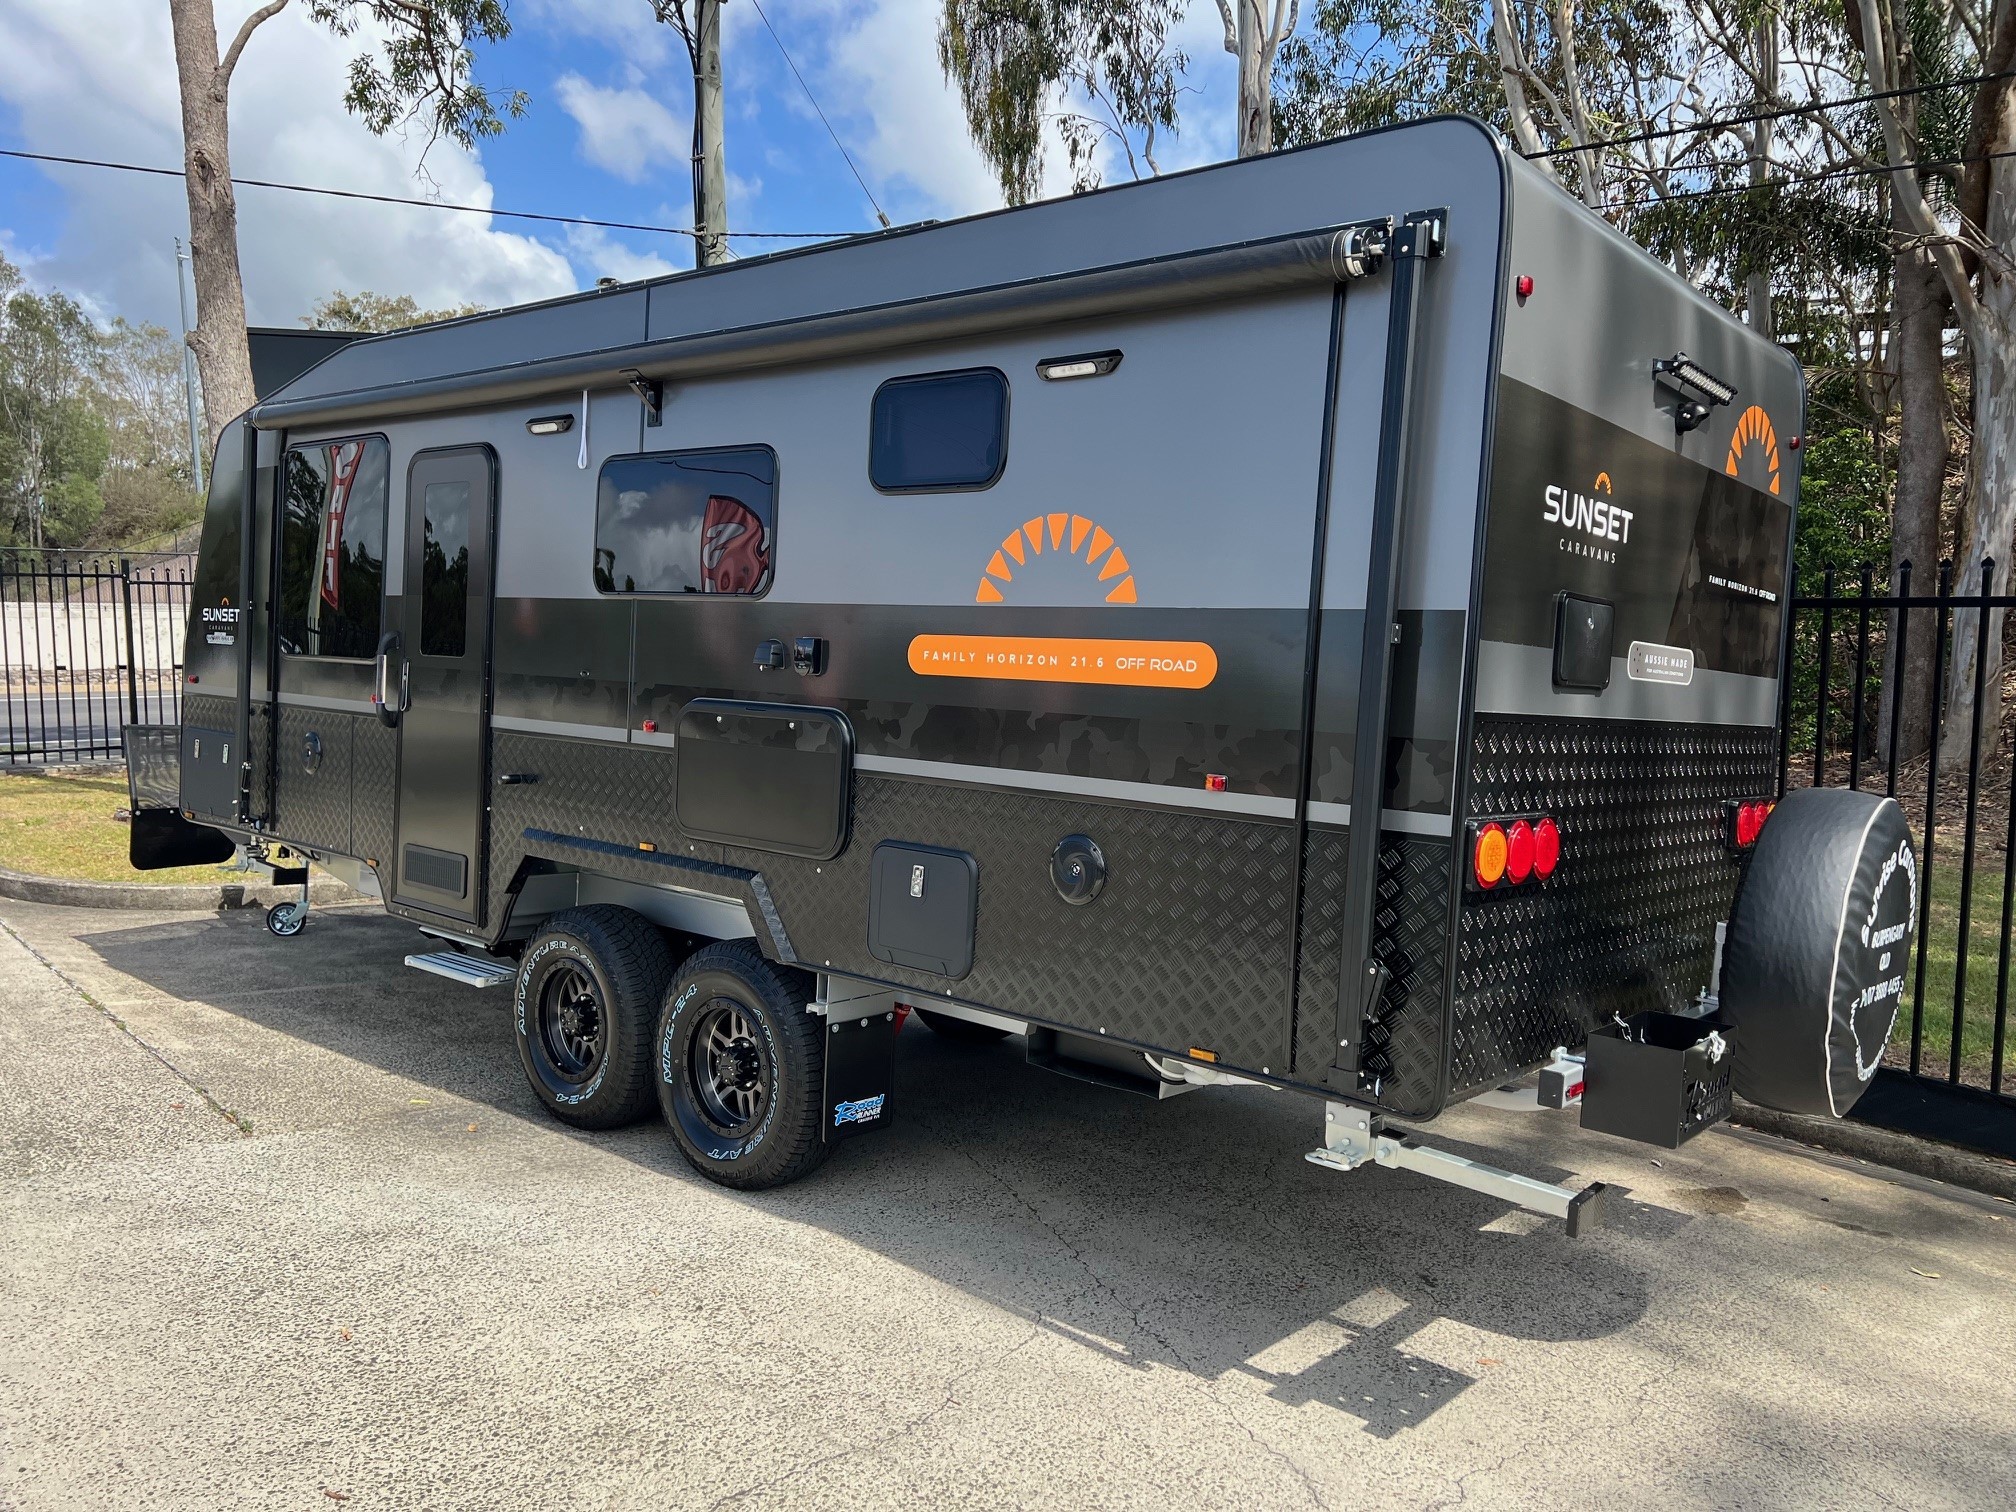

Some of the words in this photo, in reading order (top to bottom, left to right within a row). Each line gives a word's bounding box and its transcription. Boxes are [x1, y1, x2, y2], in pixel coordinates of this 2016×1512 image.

[1543, 484, 1634, 544] SUNSET
[1559, 538, 1617, 564] CARAVANS
[1708, 575, 1727, 587] FAMILY
[1728, 580, 1748, 593] HORIZON
[202, 607, 240, 622] SUNSET
[923, 650, 976, 663] FAMILY
[987, 652, 1059, 667] HORIZON
[1071, 656, 1105, 669] 21.6
[1115, 657, 1146, 671] OFF
[1149, 658, 1198, 673] ROAD
[1644, 654, 1668, 667] AUSSIE
[1670, 658, 1688, 669] MADE
[1861, 850, 1897, 948] Sunrise
[1897, 839, 1916, 933] Caravans
[517, 939, 569, 1037] ADVENTURE
[569, 945, 596, 970] A/T
[662, 983, 698, 1084] MPC-24
[745, 1008, 780, 1156] ADVENTURE
[834, 1093, 885, 1127] Road
[707, 1147, 744, 1161] A/T
